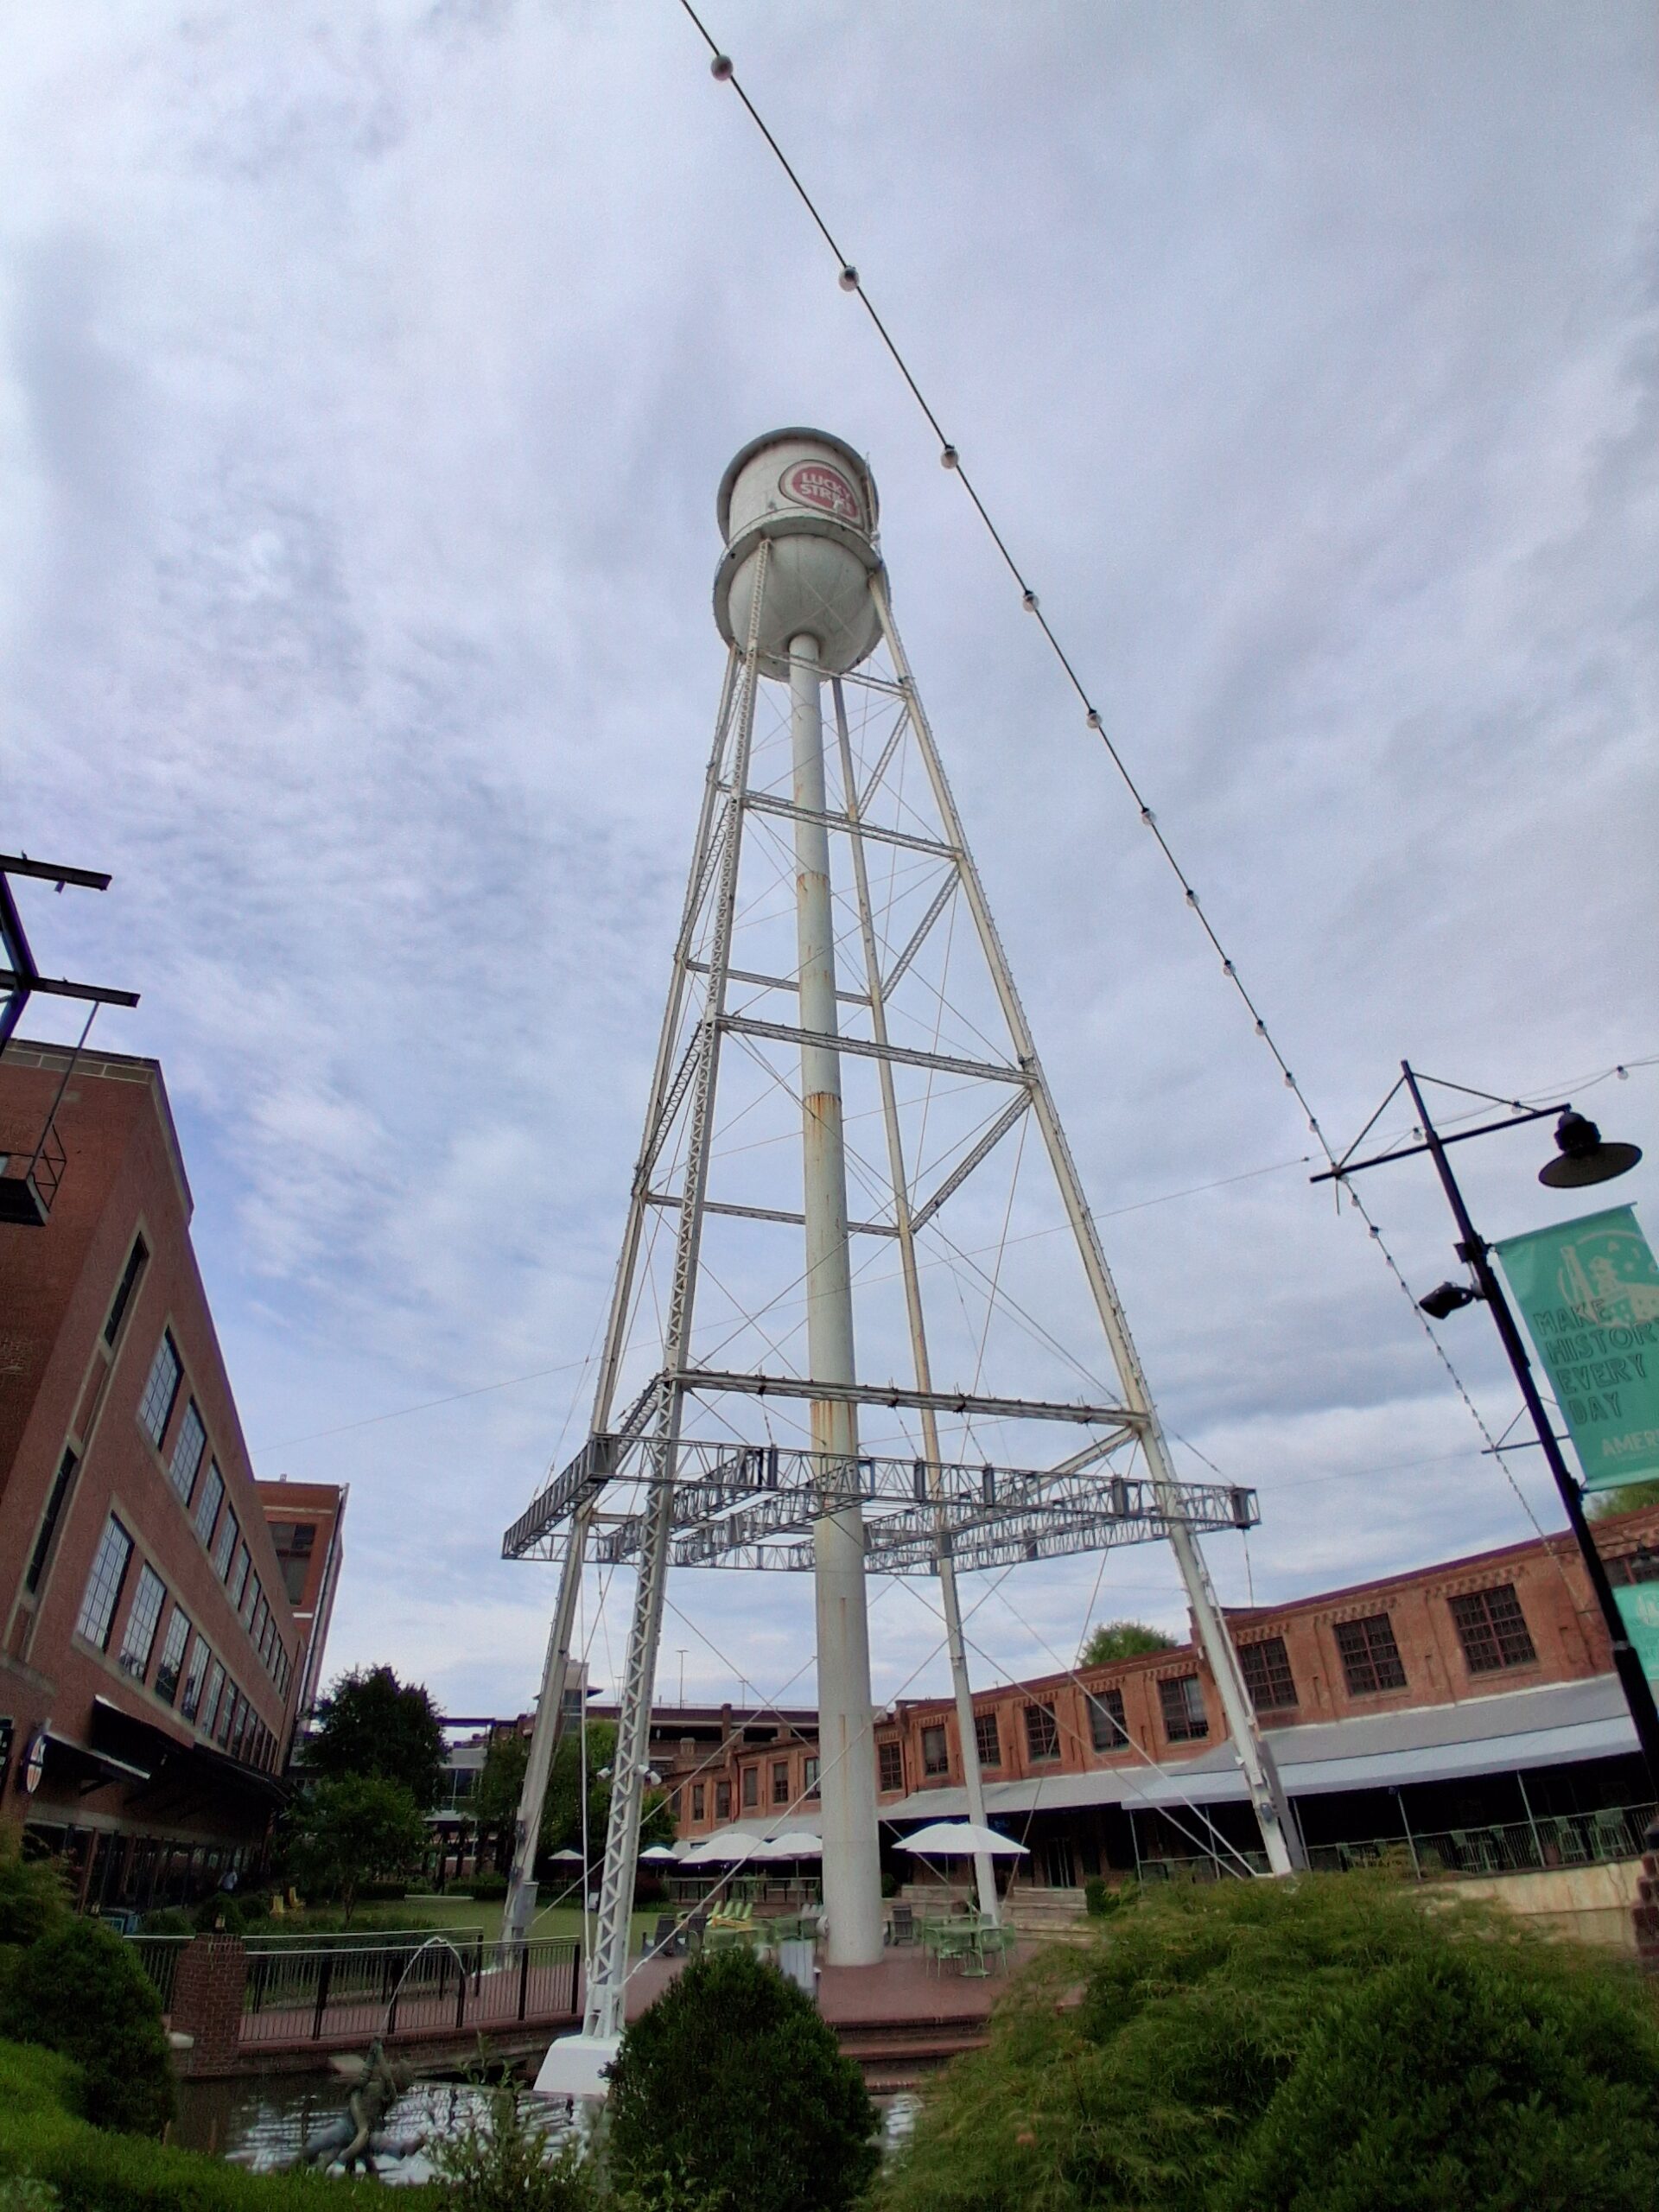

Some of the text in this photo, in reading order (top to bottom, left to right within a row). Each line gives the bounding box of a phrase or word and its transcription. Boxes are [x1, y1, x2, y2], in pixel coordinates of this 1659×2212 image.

[799, 483, 852, 513] STRIE
[801, 473, 850, 499] LUCKY
[1533, 1299, 1611, 1335] MAKE
[1546, 1316, 1659, 1365] HISTOR
[1557, 1354, 1646, 1395] EVERY
[1568, 1391, 1622, 1425] DAY
